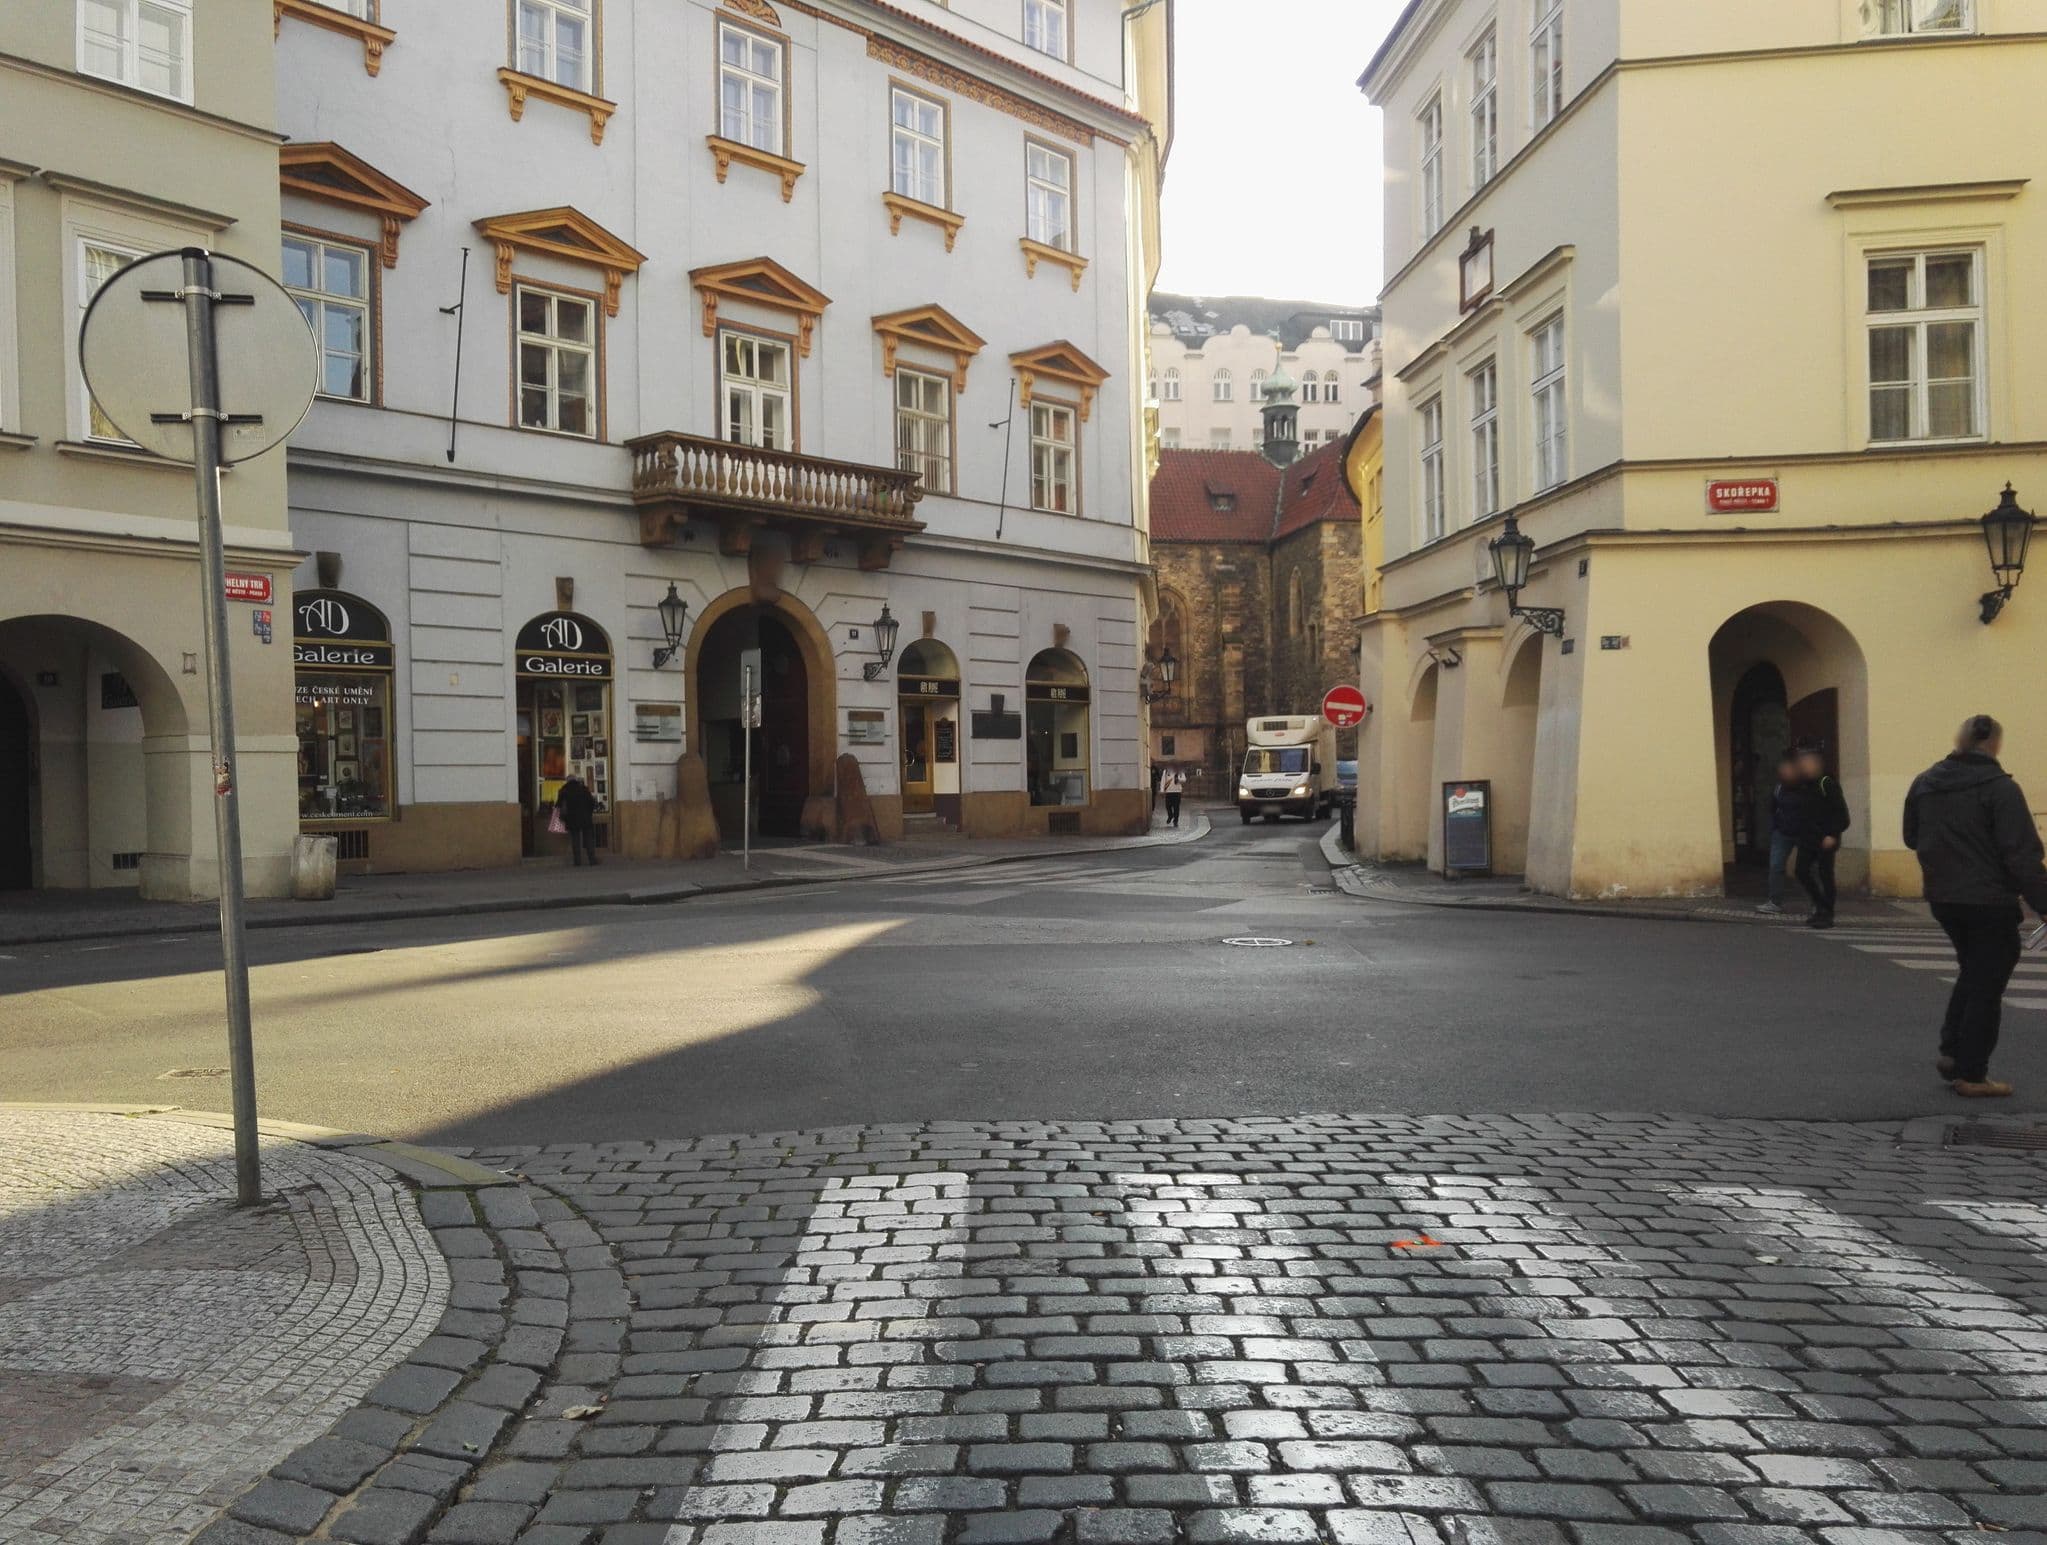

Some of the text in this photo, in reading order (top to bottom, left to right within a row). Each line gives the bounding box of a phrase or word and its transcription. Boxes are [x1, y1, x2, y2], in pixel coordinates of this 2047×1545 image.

[1716, 486, 1771, 498] SKOŘEPKA
[251, 580, 264, 590] TRH
[299, 599, 349, 634] AD
[541, 618, 583, 650] AD
[526, 657, 603, 675] Galerie
[343, 696, 369, 705] ONLY
